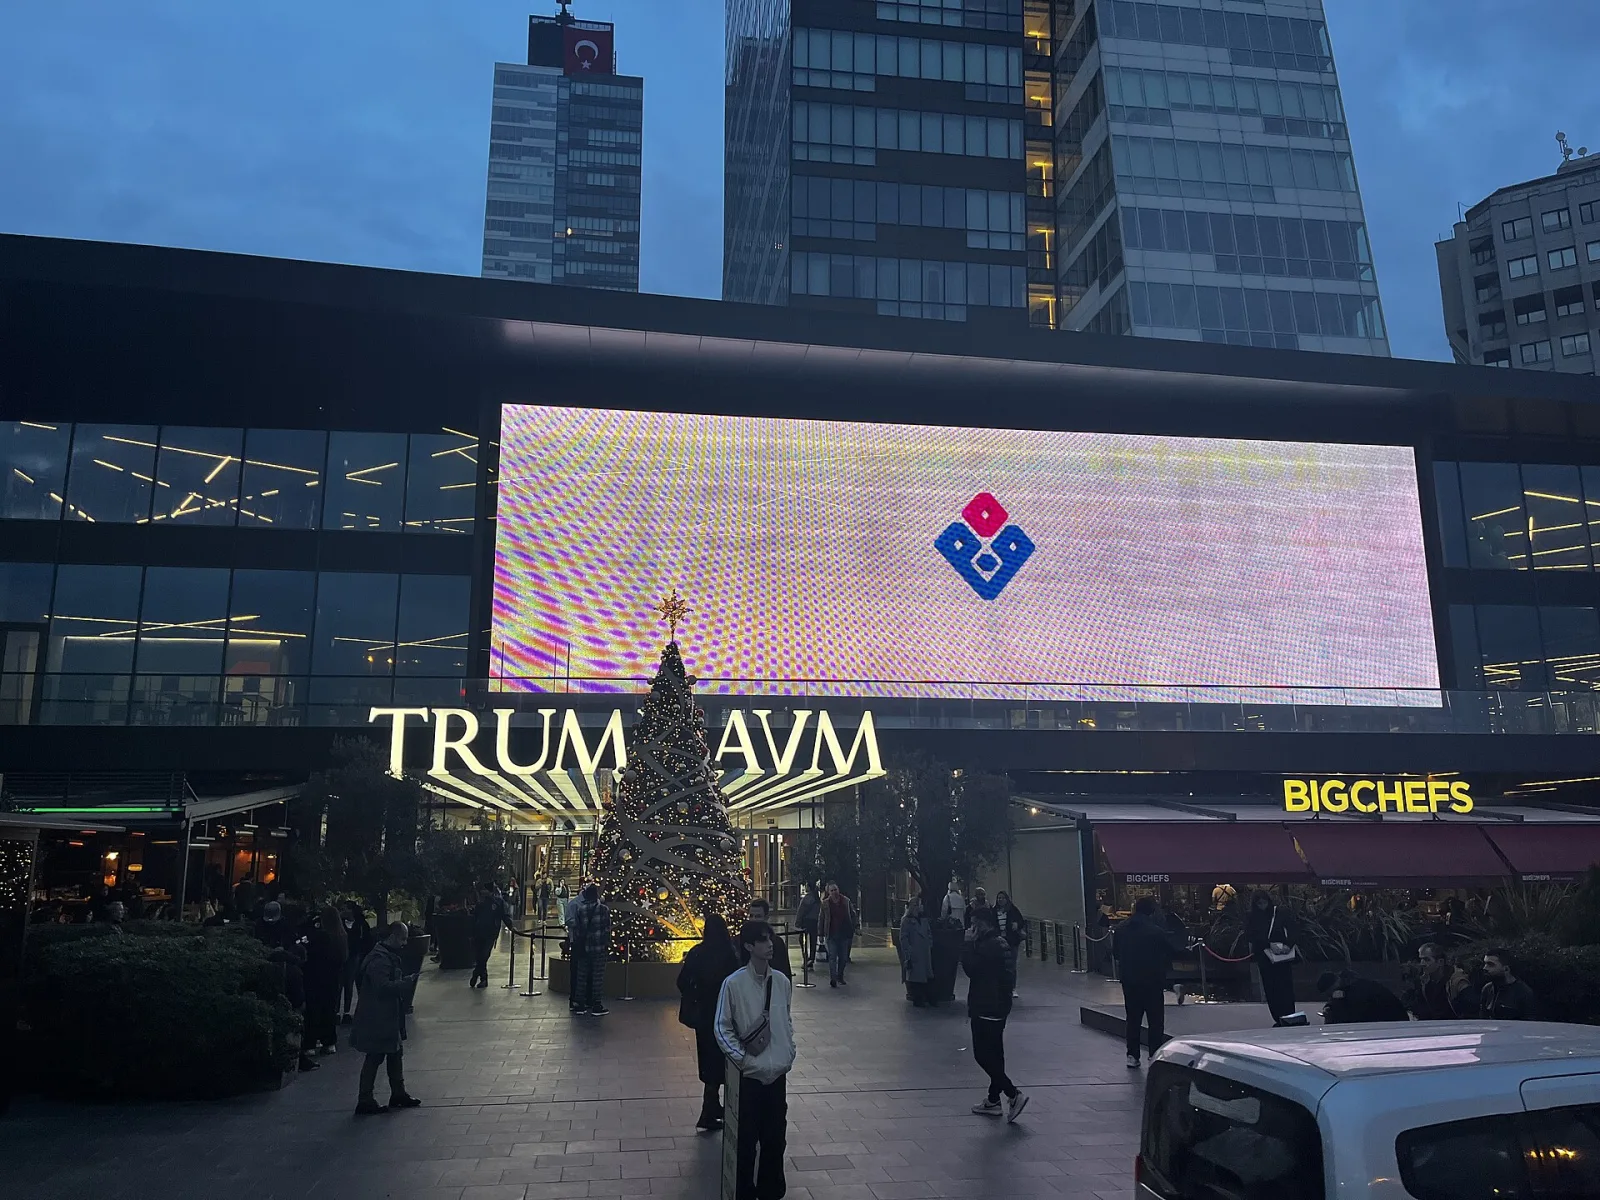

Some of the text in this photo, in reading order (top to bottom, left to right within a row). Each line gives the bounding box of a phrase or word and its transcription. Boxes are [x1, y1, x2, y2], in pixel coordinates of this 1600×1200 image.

[369, 707, 886, 779] TRUM AVM
[1283, 780, 1474, 813] BIGCHEFS
[1126, 874, 1170, 883] BIGCHEFS
